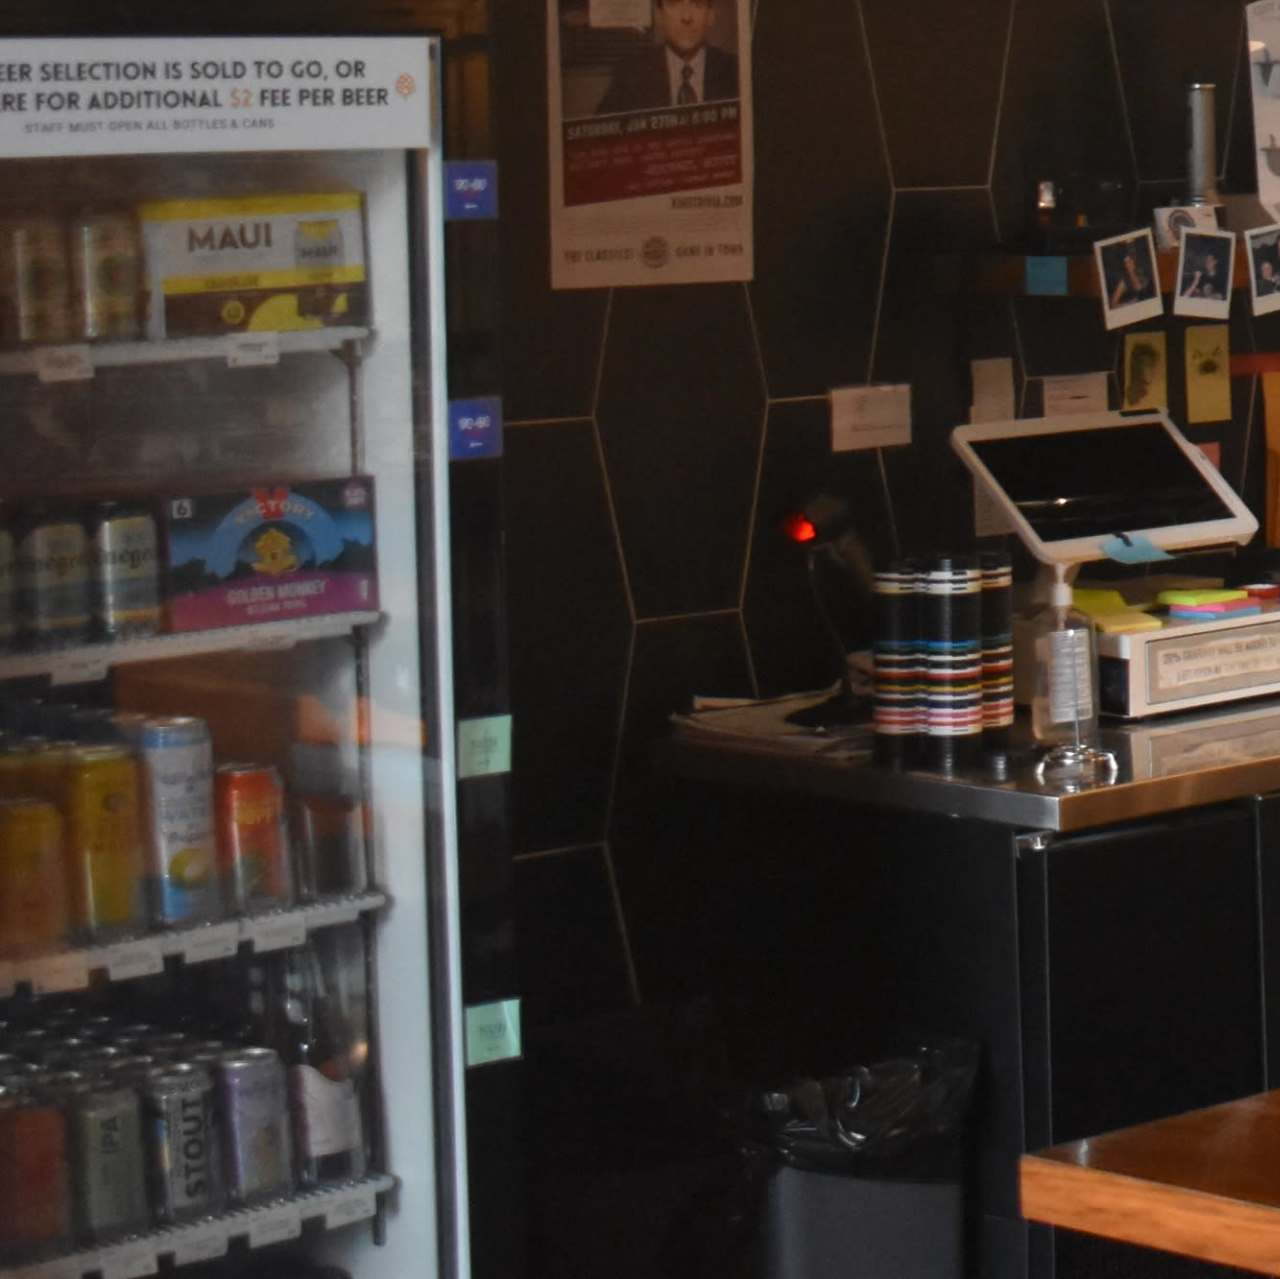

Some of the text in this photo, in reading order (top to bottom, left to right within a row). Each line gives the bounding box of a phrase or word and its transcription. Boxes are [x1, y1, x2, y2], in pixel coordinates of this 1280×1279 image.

[41, 61, 156, 82] SELECTION
[164, 62, 182, 80] IS
[190, 61, 246, 79] SOLD
[254, 61, 283, 79] TO
[291, 60, 328, 81] GO,
[336, 60, 366, 79] OR
[0, 87, 389, 112] RE FOR ADDITIONAL $2 FEE PER BEER
[24, 121, 63, 134] STAFF
[69, 120, 104, 133] MUST
[108, 120, 142, 132] OPEN
[146, 120, 169, 132] ALL
[172, 119, 228, 131] BOTTLES
[243, 118, 275, 130] CANS
[187, 221, 273, 253] MAUI
[234, 500, 314, 527] VICTORY
[226, 583, 275, 605] GOLDEN
[100, 1116, 119, 1155] IPA
[181, 1098, 207, 1198] STOUT
